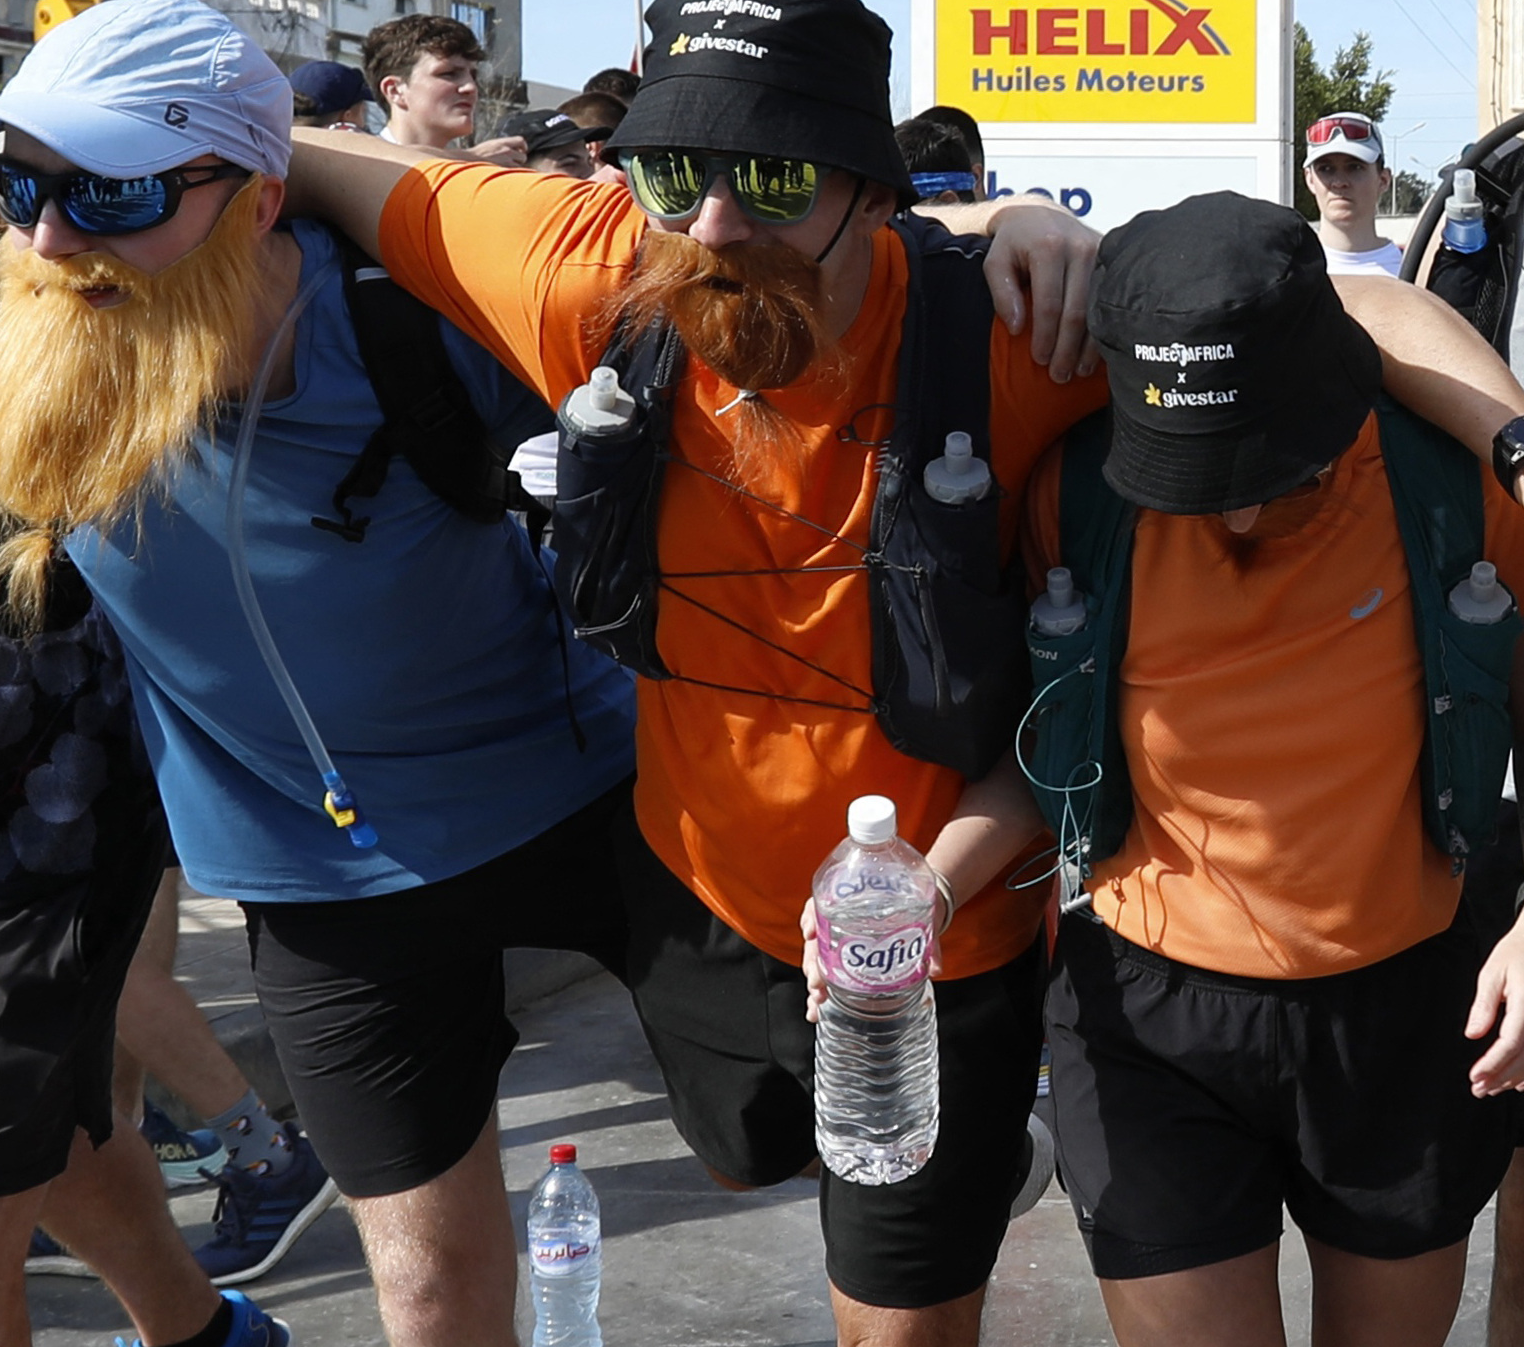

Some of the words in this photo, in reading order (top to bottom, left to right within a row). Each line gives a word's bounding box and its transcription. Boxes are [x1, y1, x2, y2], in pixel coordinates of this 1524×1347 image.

[733, 0, 782, 21] AFRICA
[688, 32, 769, 59] givestar
[972, 66, 1066, 92] Huiles
[1076, 68, 1205, 92] Moteurs
[1187, 343, 1235, 362] AFRICA
[1162, 387, 1238, 408] givestar
[847, 936, 922, 974] Safia
[154, 1143, 197, 1159] HOKA
